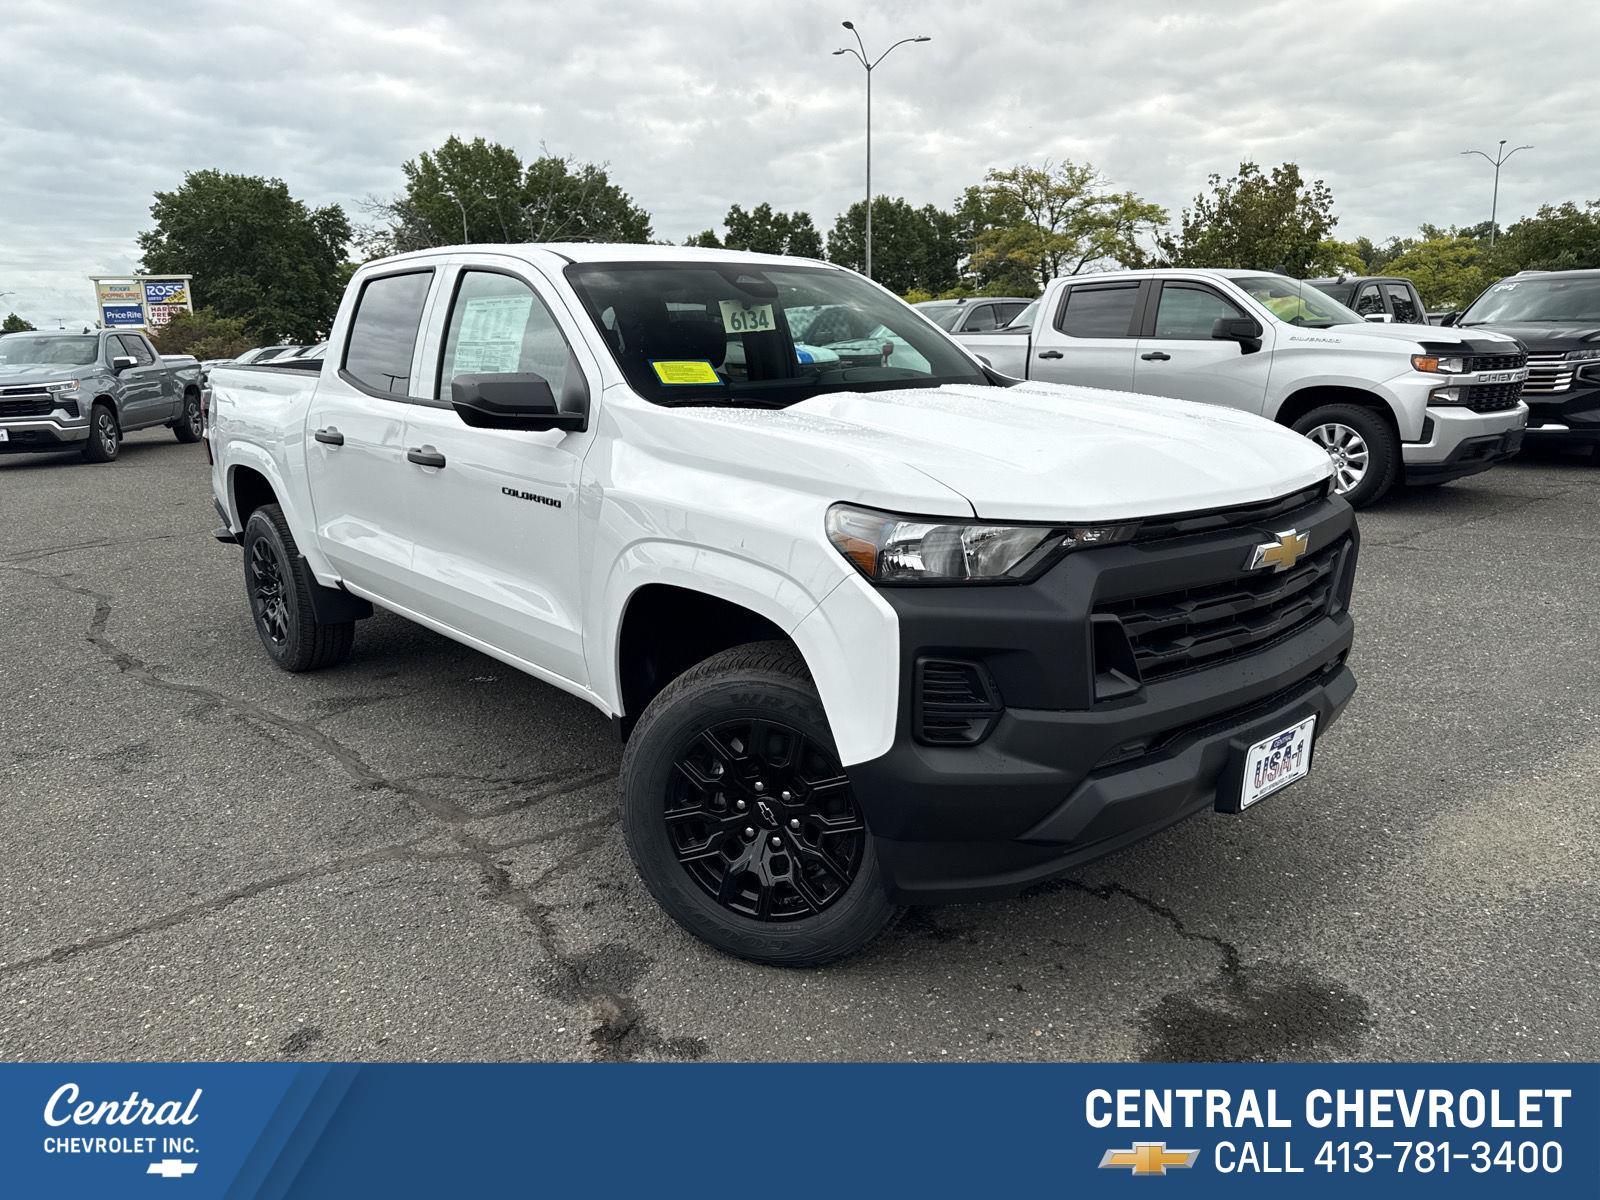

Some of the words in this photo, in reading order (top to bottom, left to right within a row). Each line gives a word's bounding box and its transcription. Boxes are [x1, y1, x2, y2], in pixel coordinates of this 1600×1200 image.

[146, 285, 182, 296] ROSS
[730, 309, 770, 331] 6134
[501, 486, 562, 509] COLORADO
[1254, 739, 1304, 789] USA-1
